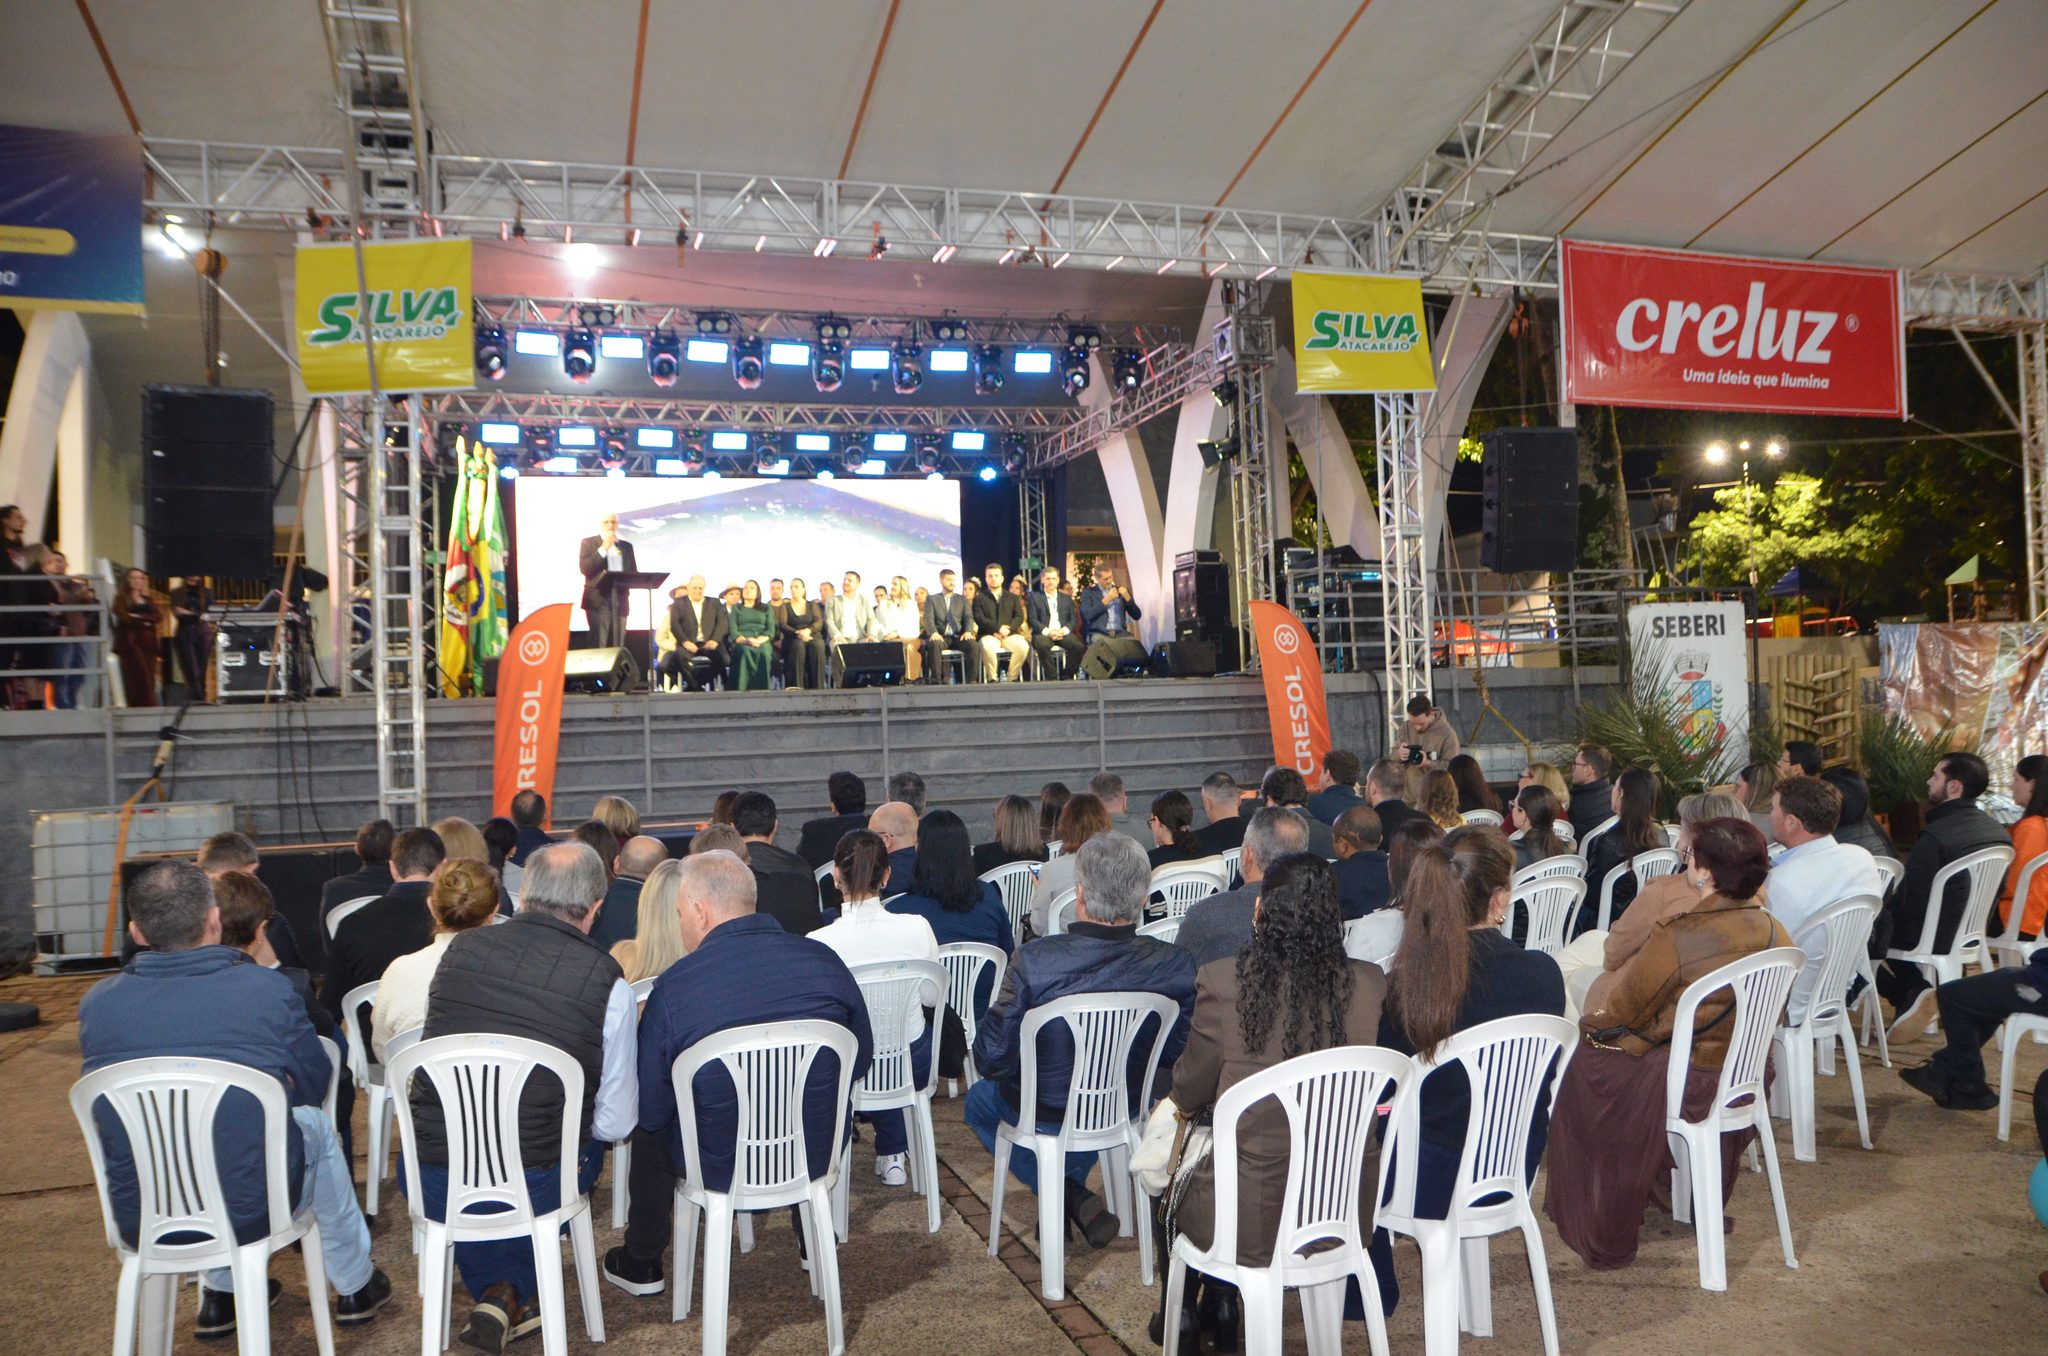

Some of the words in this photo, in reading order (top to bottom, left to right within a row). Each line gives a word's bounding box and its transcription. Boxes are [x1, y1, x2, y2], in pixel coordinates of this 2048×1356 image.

[309, 287, 463, 344] SILVA
[351, 325, 446, 341] AACAREJO
[1305, 311, 1420, 349] SILVA
[1615, 281, 1838, 364] creluz
[1340, 341, 1411, 352] ATACAREJO
[1683, 367, 1715, 384] Uma
[1717, 368, 1751, 385] ideia
[1753, 374, 1779, 389] que
[1781, 371, 1830, 389] ilumina
[1652, 613, 1726, 639] SEBERI
[516, 679, 543, 793] RESOL
[1284, 665, 1315, 776] CRESOL
